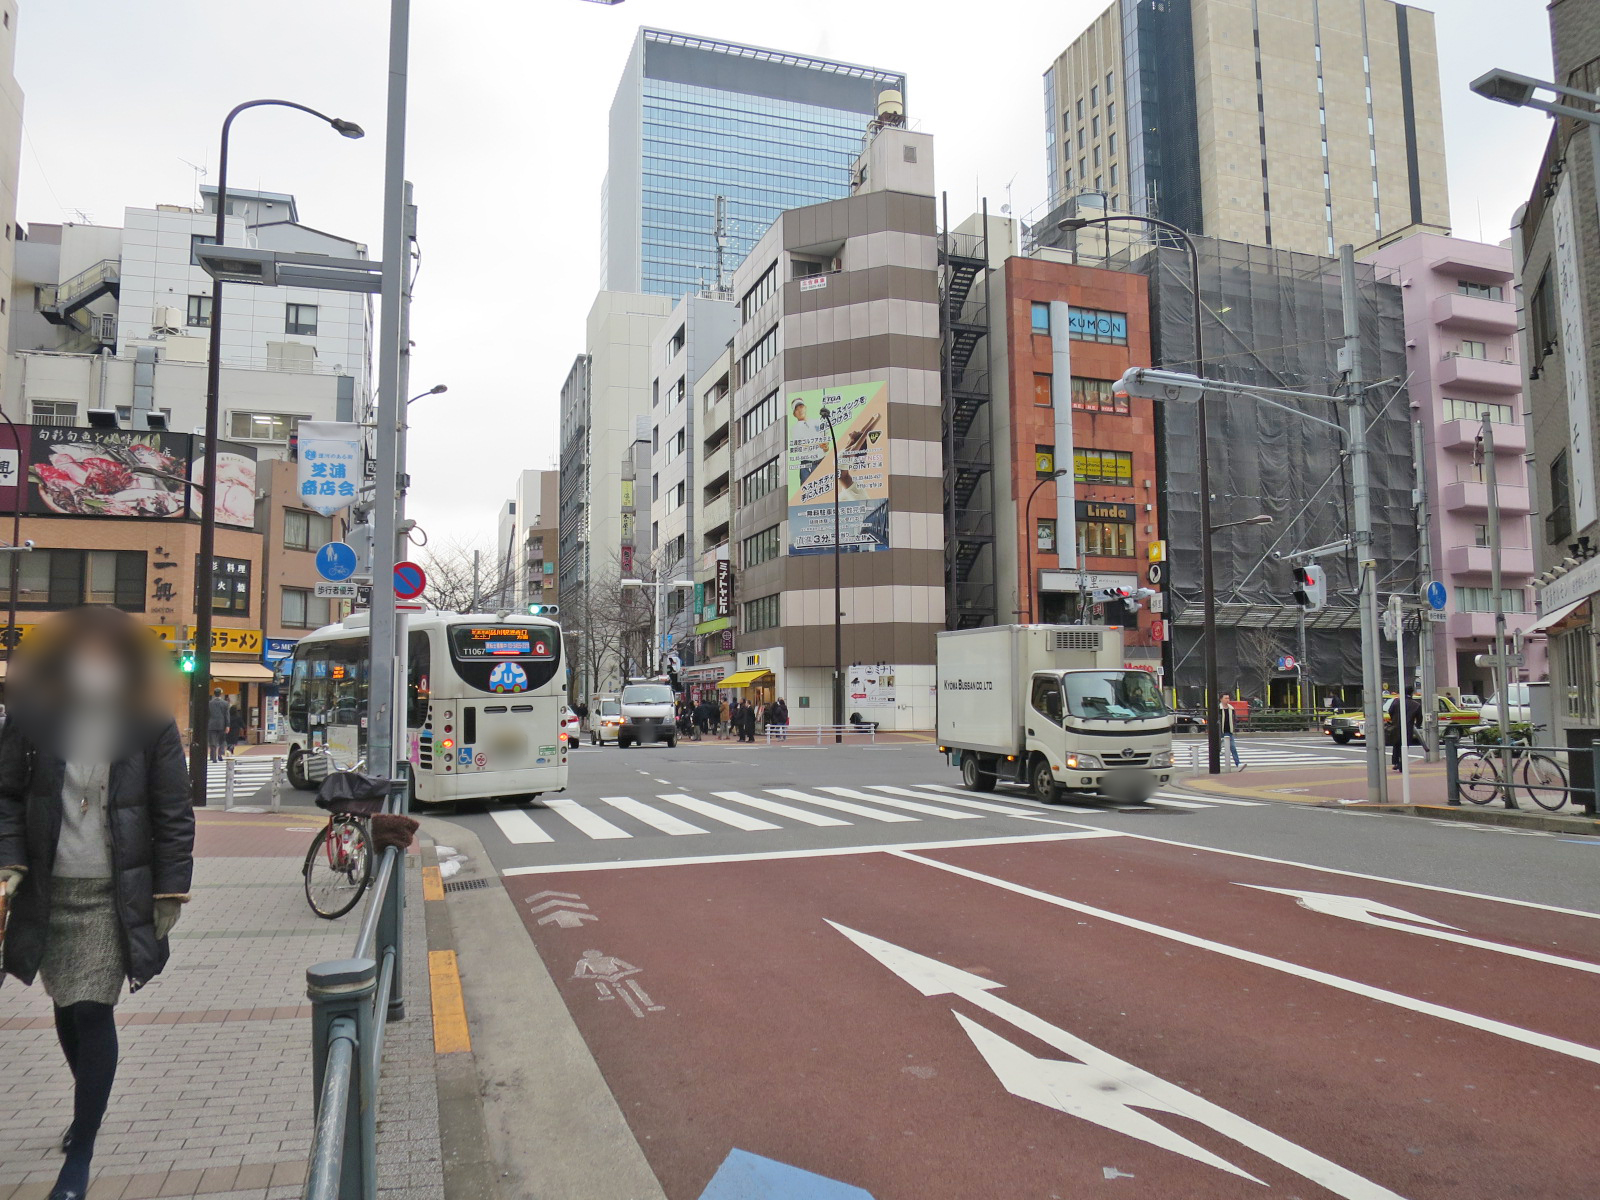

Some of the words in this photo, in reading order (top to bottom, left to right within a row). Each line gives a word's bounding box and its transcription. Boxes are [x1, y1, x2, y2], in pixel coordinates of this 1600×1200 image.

[1069, 317, 1121, 334] KUMON
[310, 462, 347, 479] 芝浦
[301, 479, 355, 497] 商店会
[1087, 503, 1127, 519] Linda
[317, 585, 355, 596] 歩行者優先
[718, 561, 729, 615] ミナトヤビル
[464, 648, 485, 656] T1067
[535, 643, 545, 655] Q
